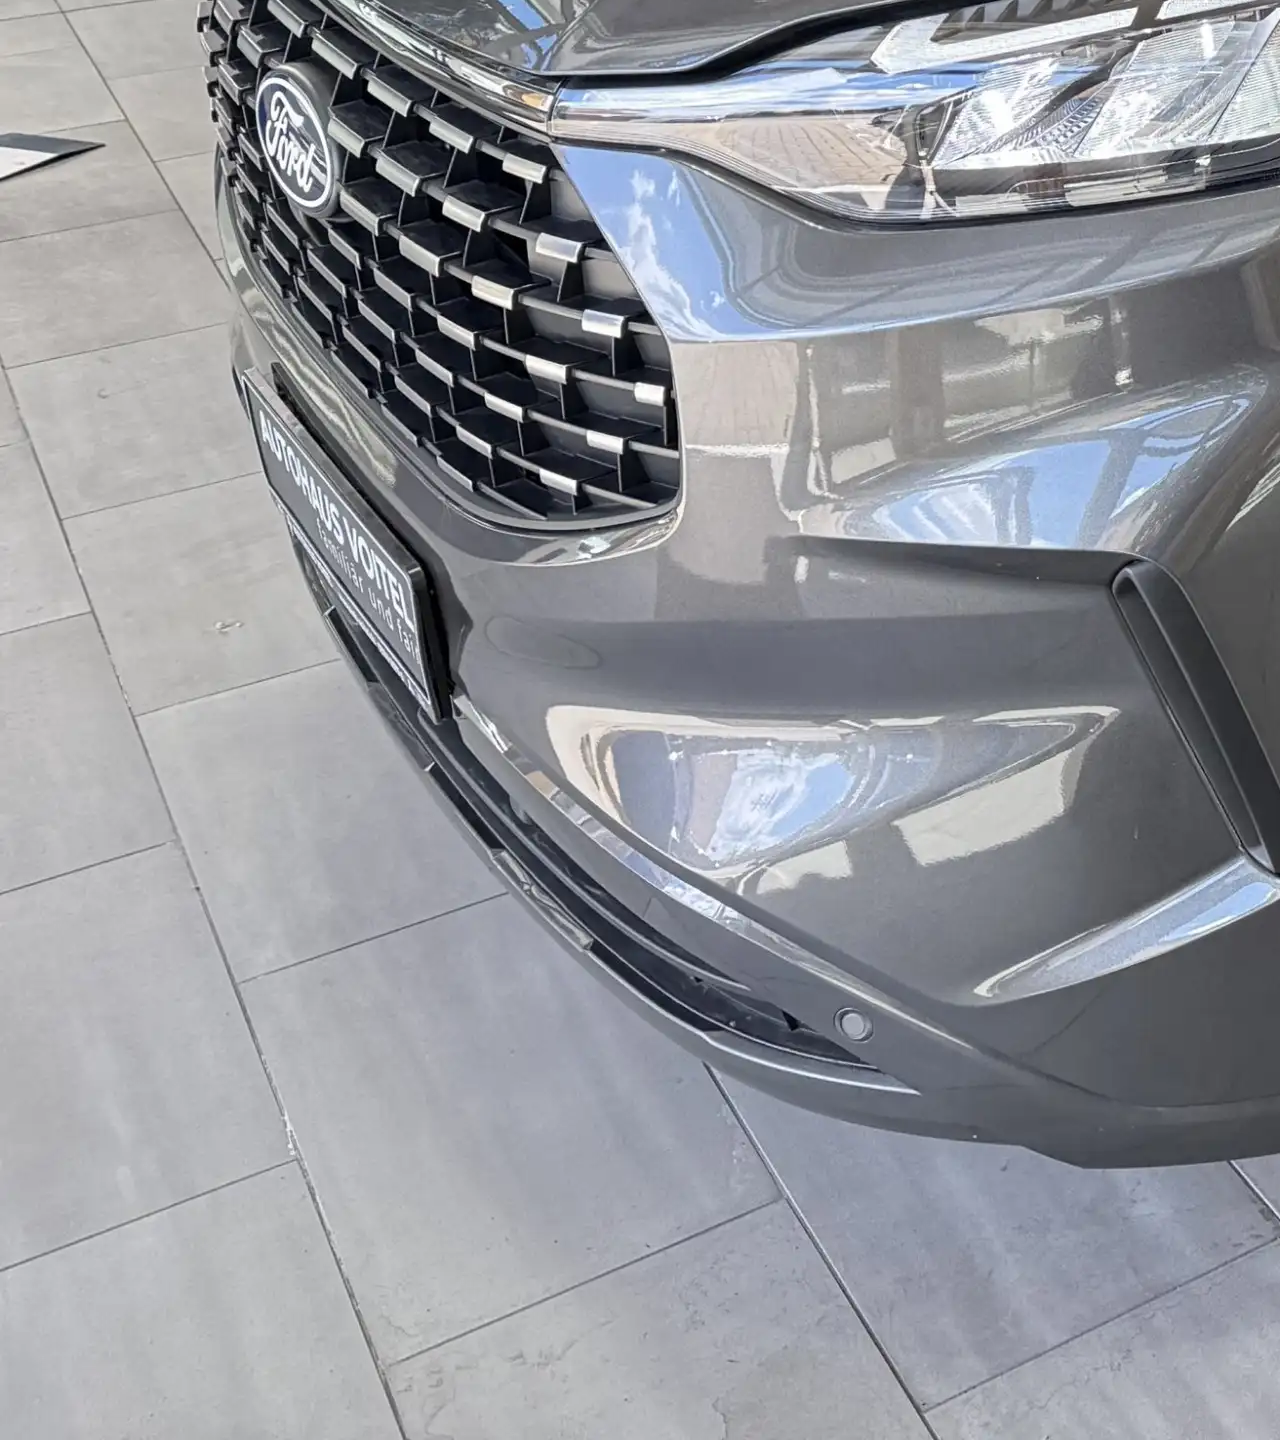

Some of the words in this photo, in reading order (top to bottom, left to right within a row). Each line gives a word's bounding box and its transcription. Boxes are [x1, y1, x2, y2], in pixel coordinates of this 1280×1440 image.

[265, 90, 316, 193] Ford
[258, 410, 345, 548] AUTOHAUS
[343, 516, 416, 633] VOITEL
